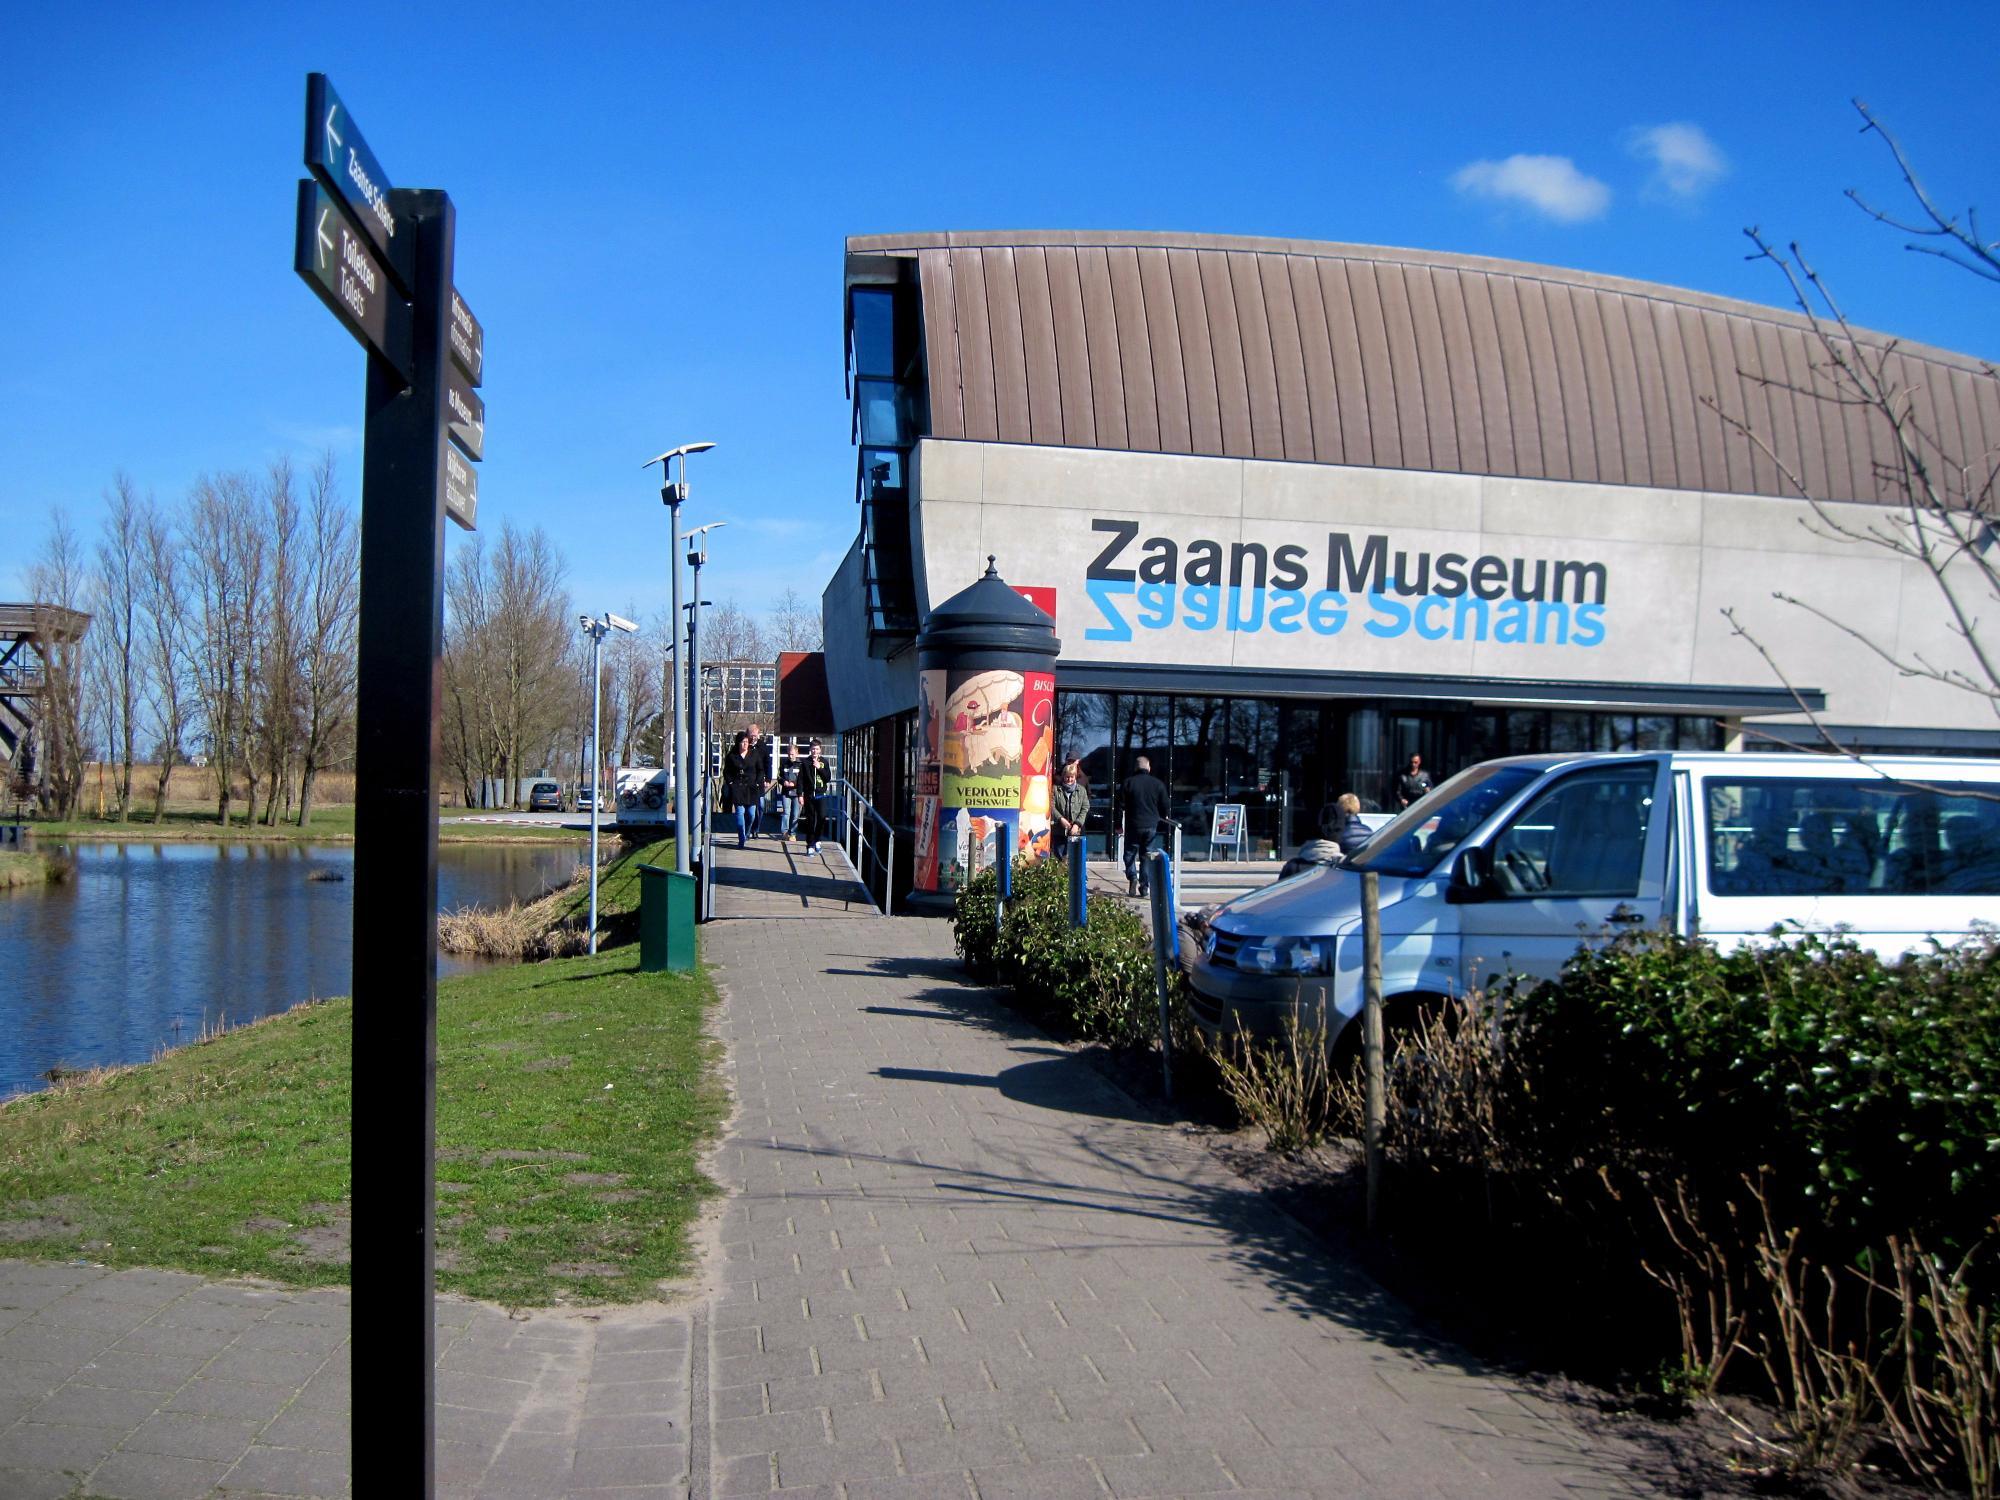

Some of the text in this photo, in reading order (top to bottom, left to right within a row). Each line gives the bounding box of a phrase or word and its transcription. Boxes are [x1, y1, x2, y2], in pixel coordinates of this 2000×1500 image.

[348, 147, 395, 238] Zaanse Schans
[340, 266, 365, 318] Toilets
[343, 229, 375, 294] Toiletten
[1086, 518, 1608, 605] Zaans Museum
[1362, 577, 1606, 647] Schans
[957, 785, 1020, 798] VERKADE'S
[965, 798, 1012, 807] BISKWIE
